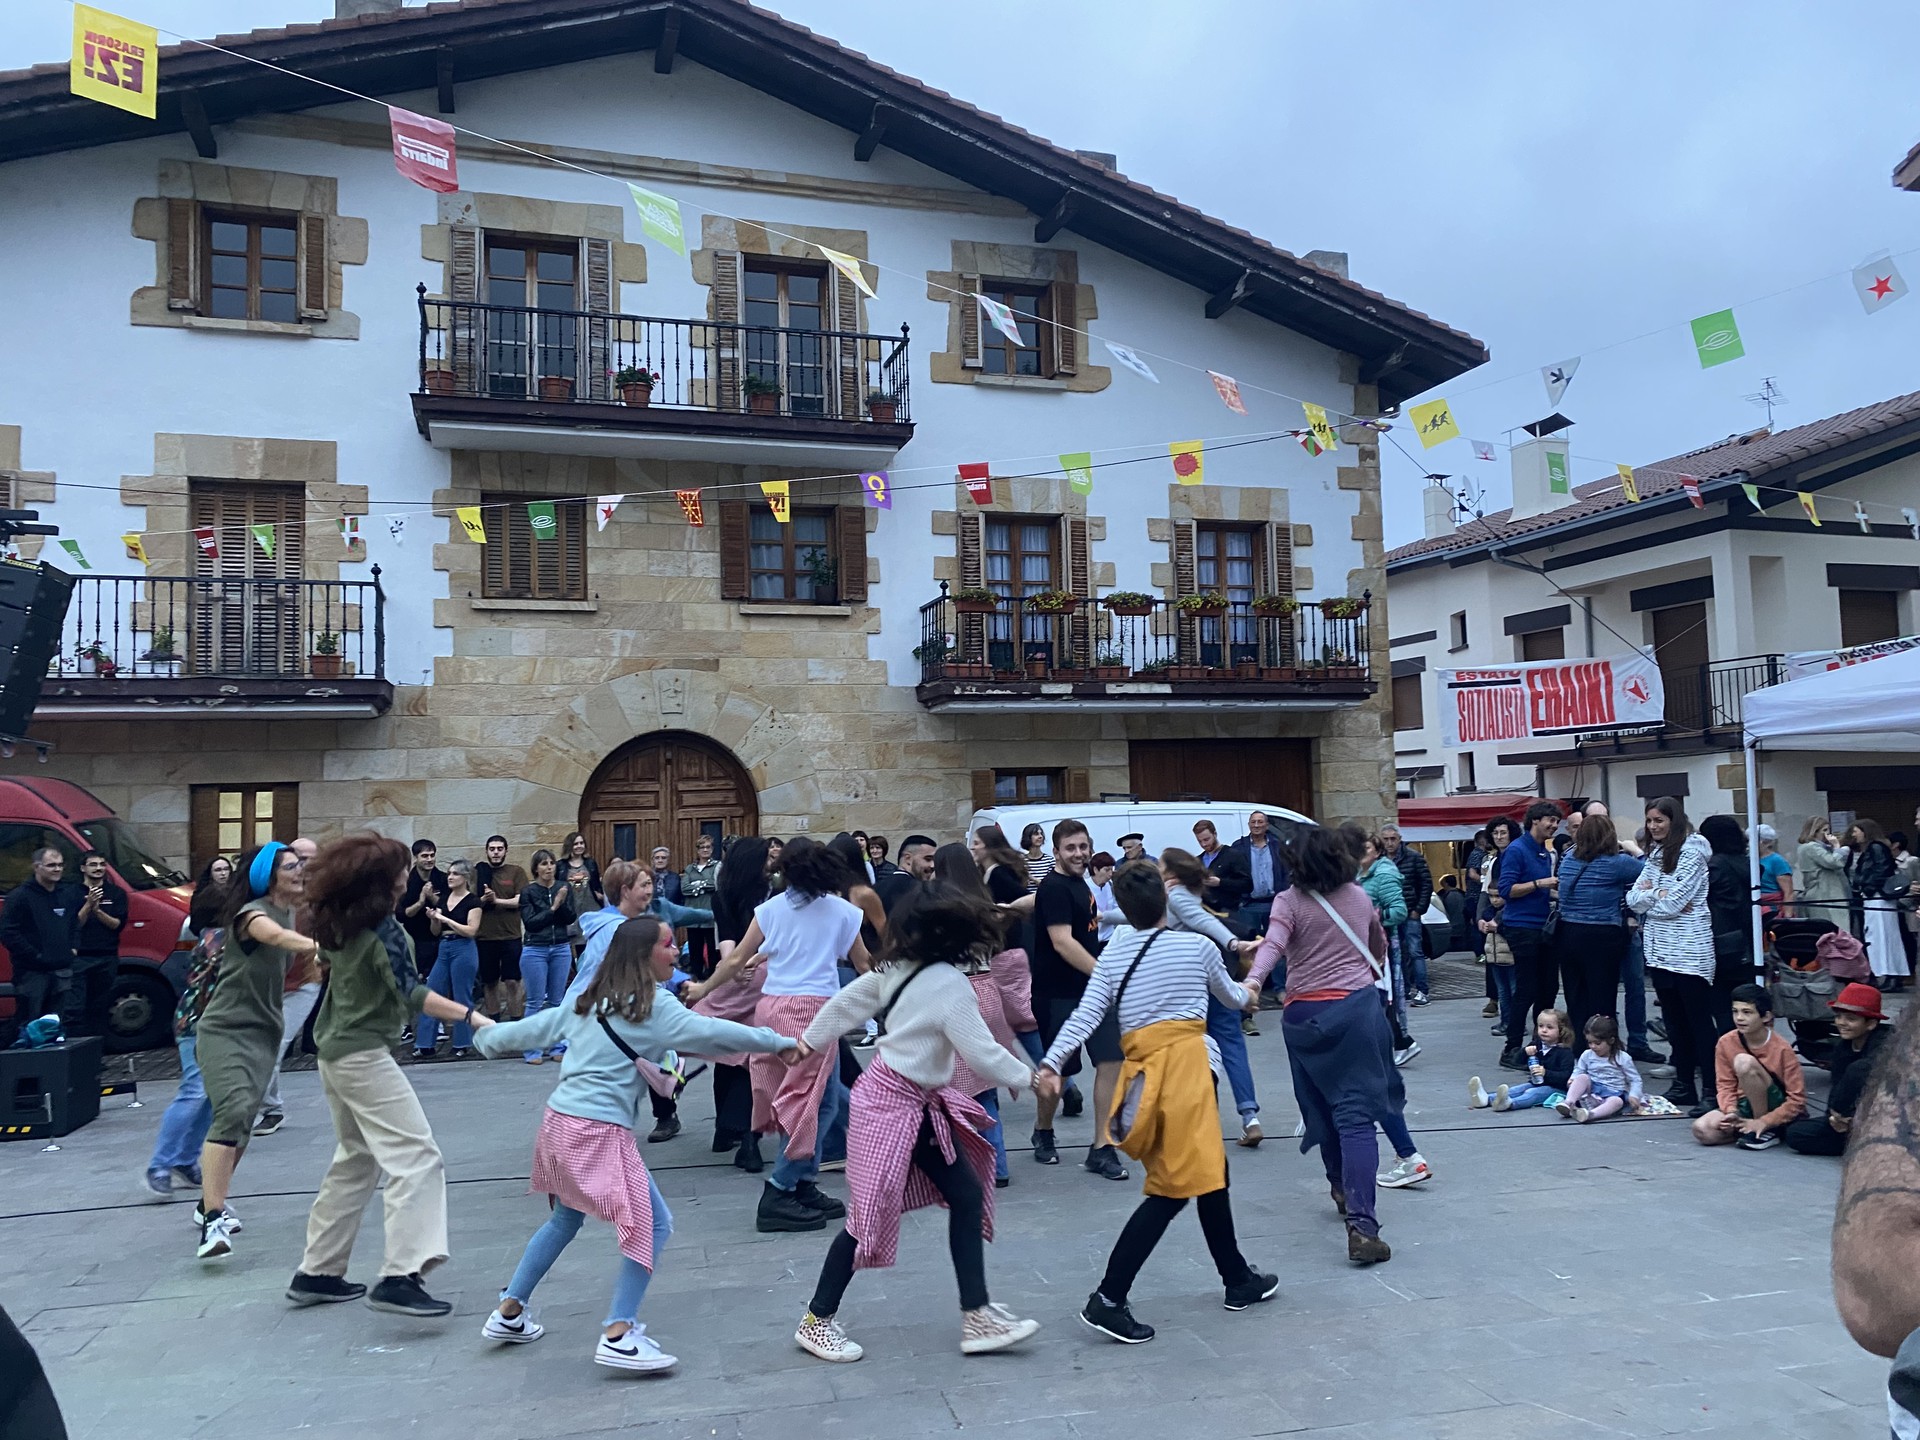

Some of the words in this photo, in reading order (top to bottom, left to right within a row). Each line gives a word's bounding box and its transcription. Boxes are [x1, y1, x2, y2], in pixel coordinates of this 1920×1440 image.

[1455, 670, 1522, 682] ESTATU
[1526, 661, 1616, 729] ERAIKI
[1457, 687, 1529, 743] SOZIALISTA
